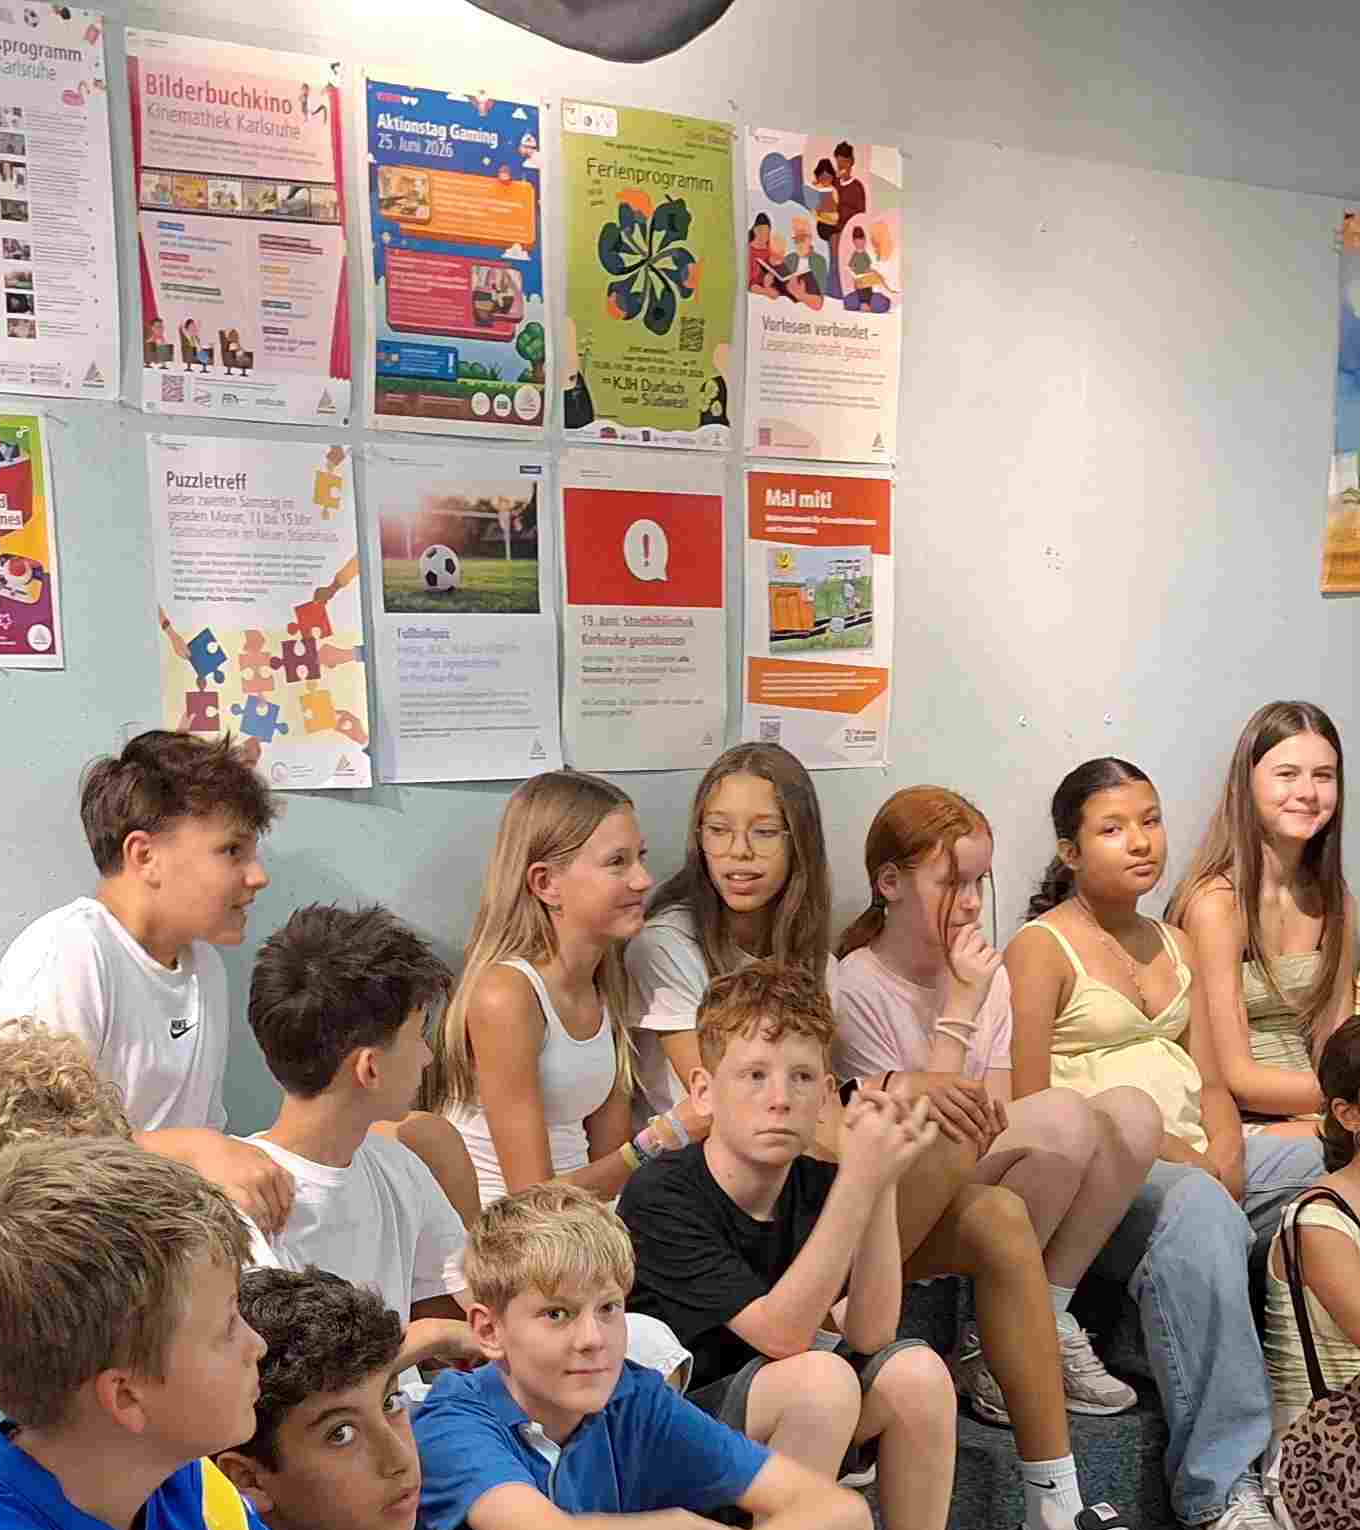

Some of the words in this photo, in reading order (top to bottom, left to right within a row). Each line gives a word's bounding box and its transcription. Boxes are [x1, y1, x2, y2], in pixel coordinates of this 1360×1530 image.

[145, 73, 293, 114] Bilderbuchkino
[146, 102, 233, 130] Kinemathek
[236, 113, 301, 138] Karlsruhe
[377, 113, 447, 141] Aktionstag
[450, 124, 499, 149] Gaming
[424, 138, 455, 158] 2026
[586, 158, 714, 192] Ferienprogramm
[815, 321, 869, 341] verbindet
[166, 470, 247, 491] Puzzletreff
[765, 488, 796, 508] Mal
[799, 489, 833, 509] mit!
